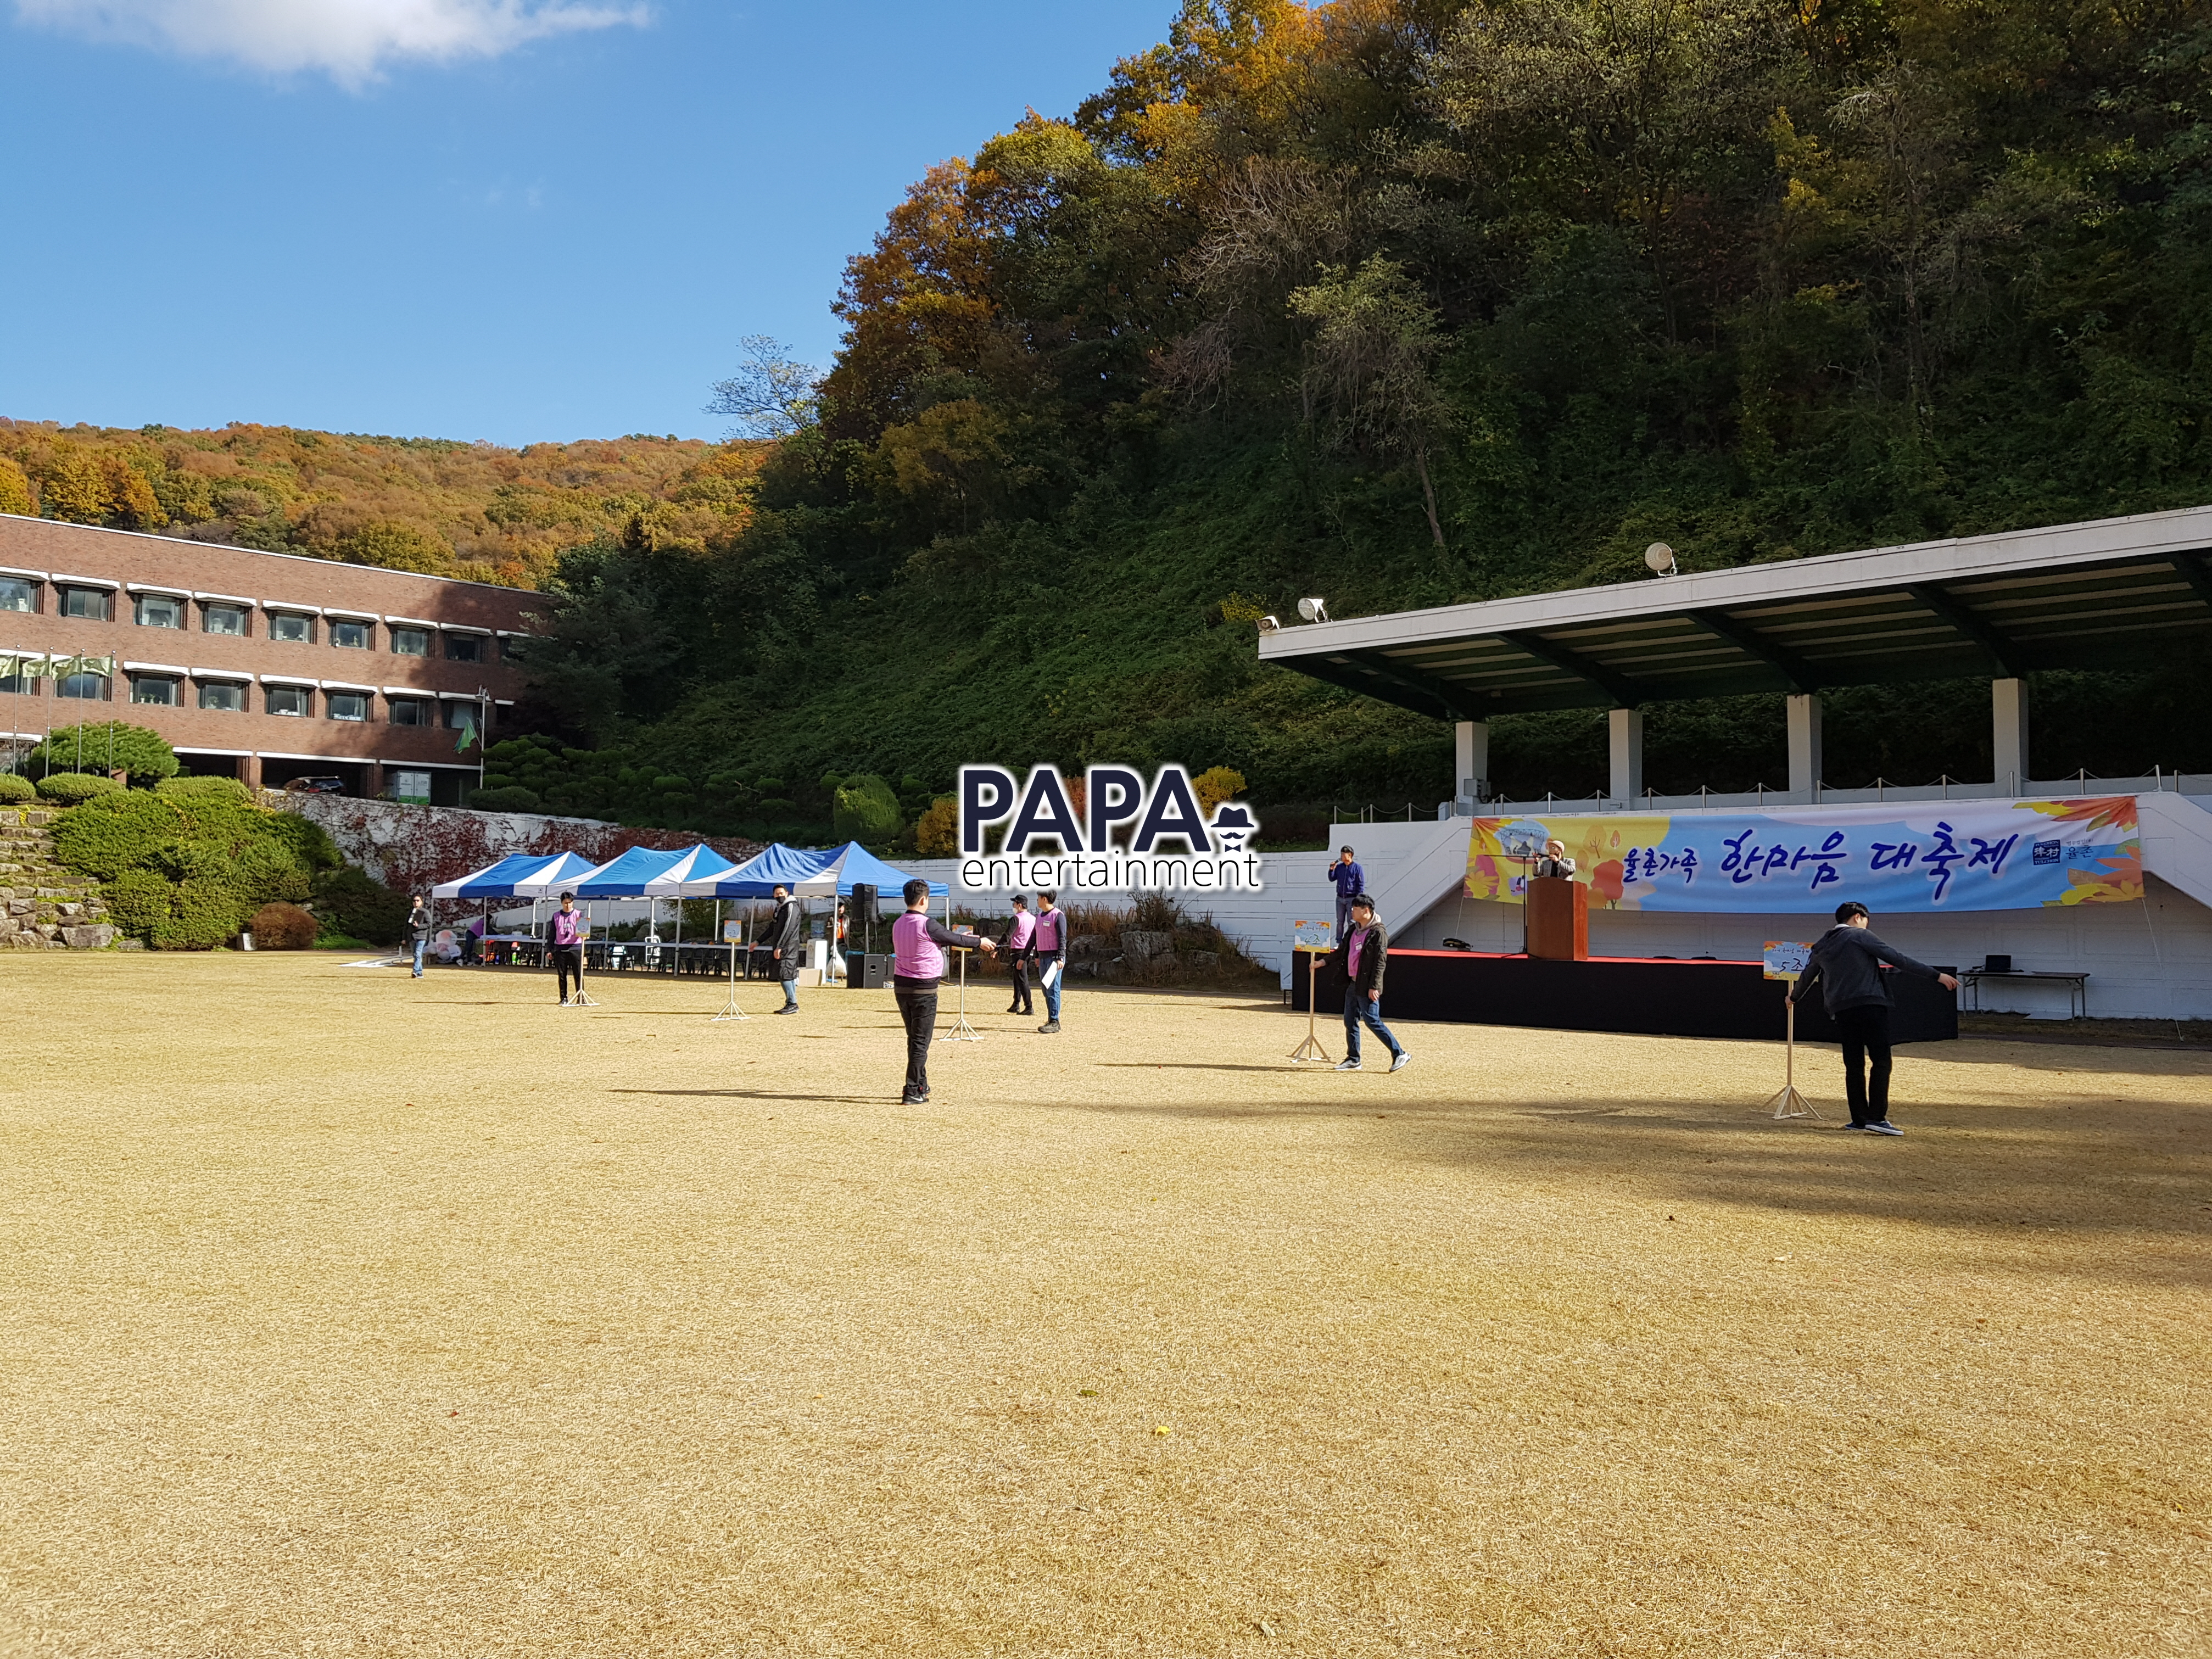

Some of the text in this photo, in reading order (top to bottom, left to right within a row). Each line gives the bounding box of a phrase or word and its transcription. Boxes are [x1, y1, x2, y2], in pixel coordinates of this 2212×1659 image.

[2065, 845, 2093, 859] 율촌
[1623, 822, 2019, 901] 율촌가족 한마음 대축제
[1779, 958, 1805, 972] 5조
